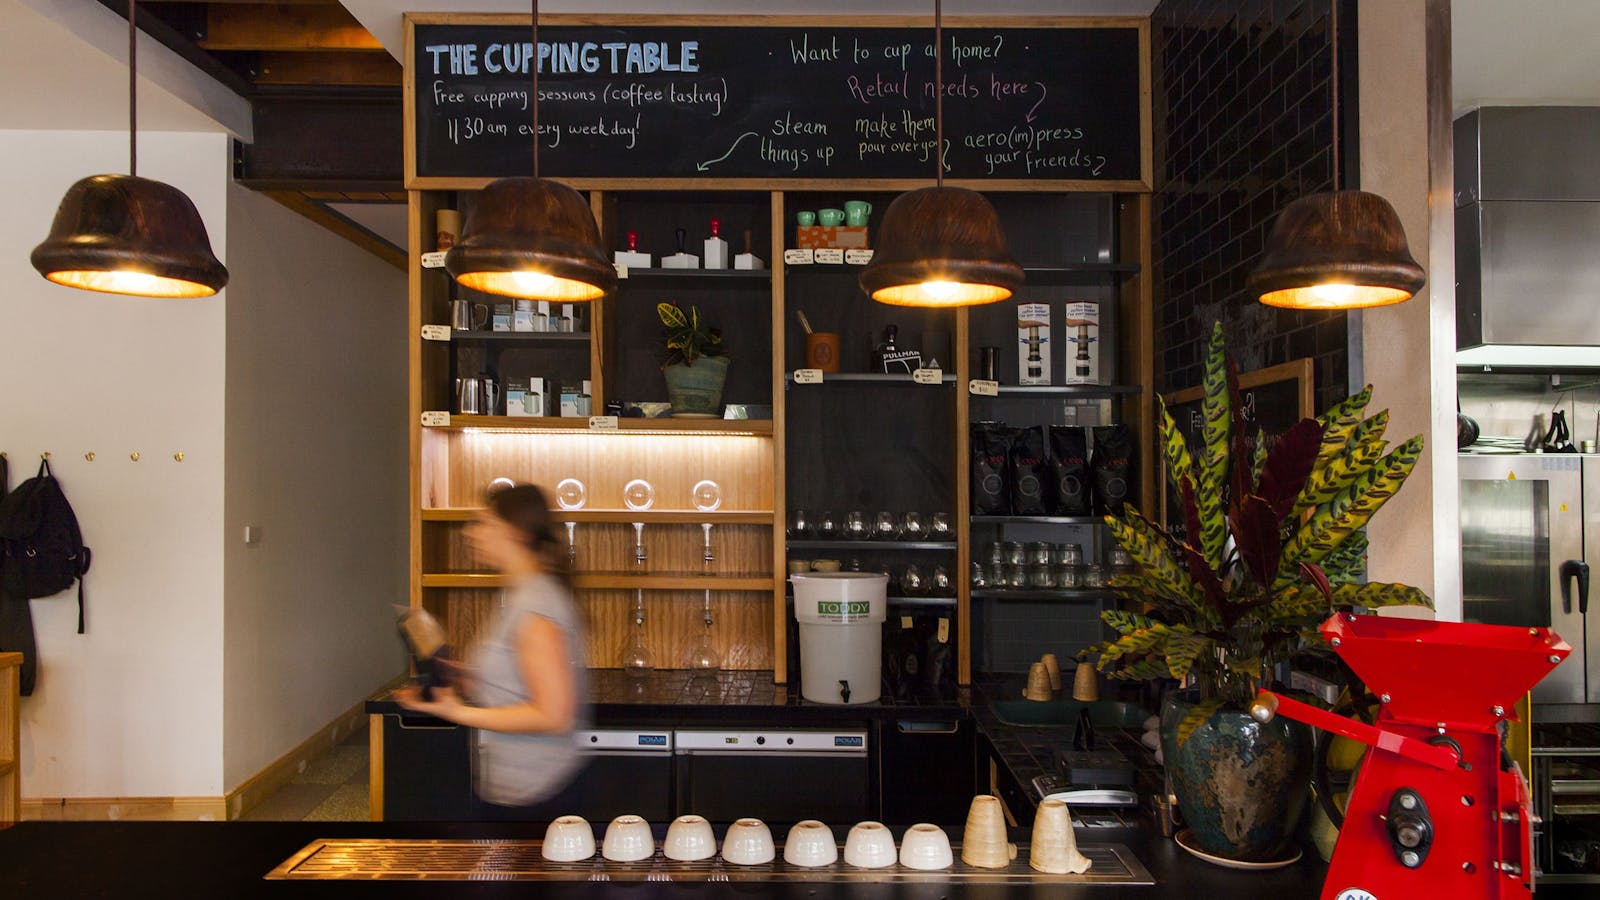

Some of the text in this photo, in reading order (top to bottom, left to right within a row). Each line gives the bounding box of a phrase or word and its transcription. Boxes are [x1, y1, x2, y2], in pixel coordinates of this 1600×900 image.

[425, 40, 700, 76] THE CUPPING TABLE
[790, 32, 841, 65] Want
[854, 37, 870, 64] to
[883, 43, 912, 72] cup
[951, 34, 1004, 68] home?
[433, 77, 728, 117] Free cupping sessions (coffee tasting)
[846, 71, 909, 105] Retail
[990, 71, 1030, 101] here
[771, 110, 829, 137] steam
[855, 108, 937, 141] make them
[964, 124, 1084, 151] aero(im)press
[760, 135, 836, 171] things up
[858, 139, 938, 162] pour over yo
[985, 148, 1092, 175] your friends
[882, 350, 920, 360] PULLMAN
[820, 602, 869, 613] TODDY
